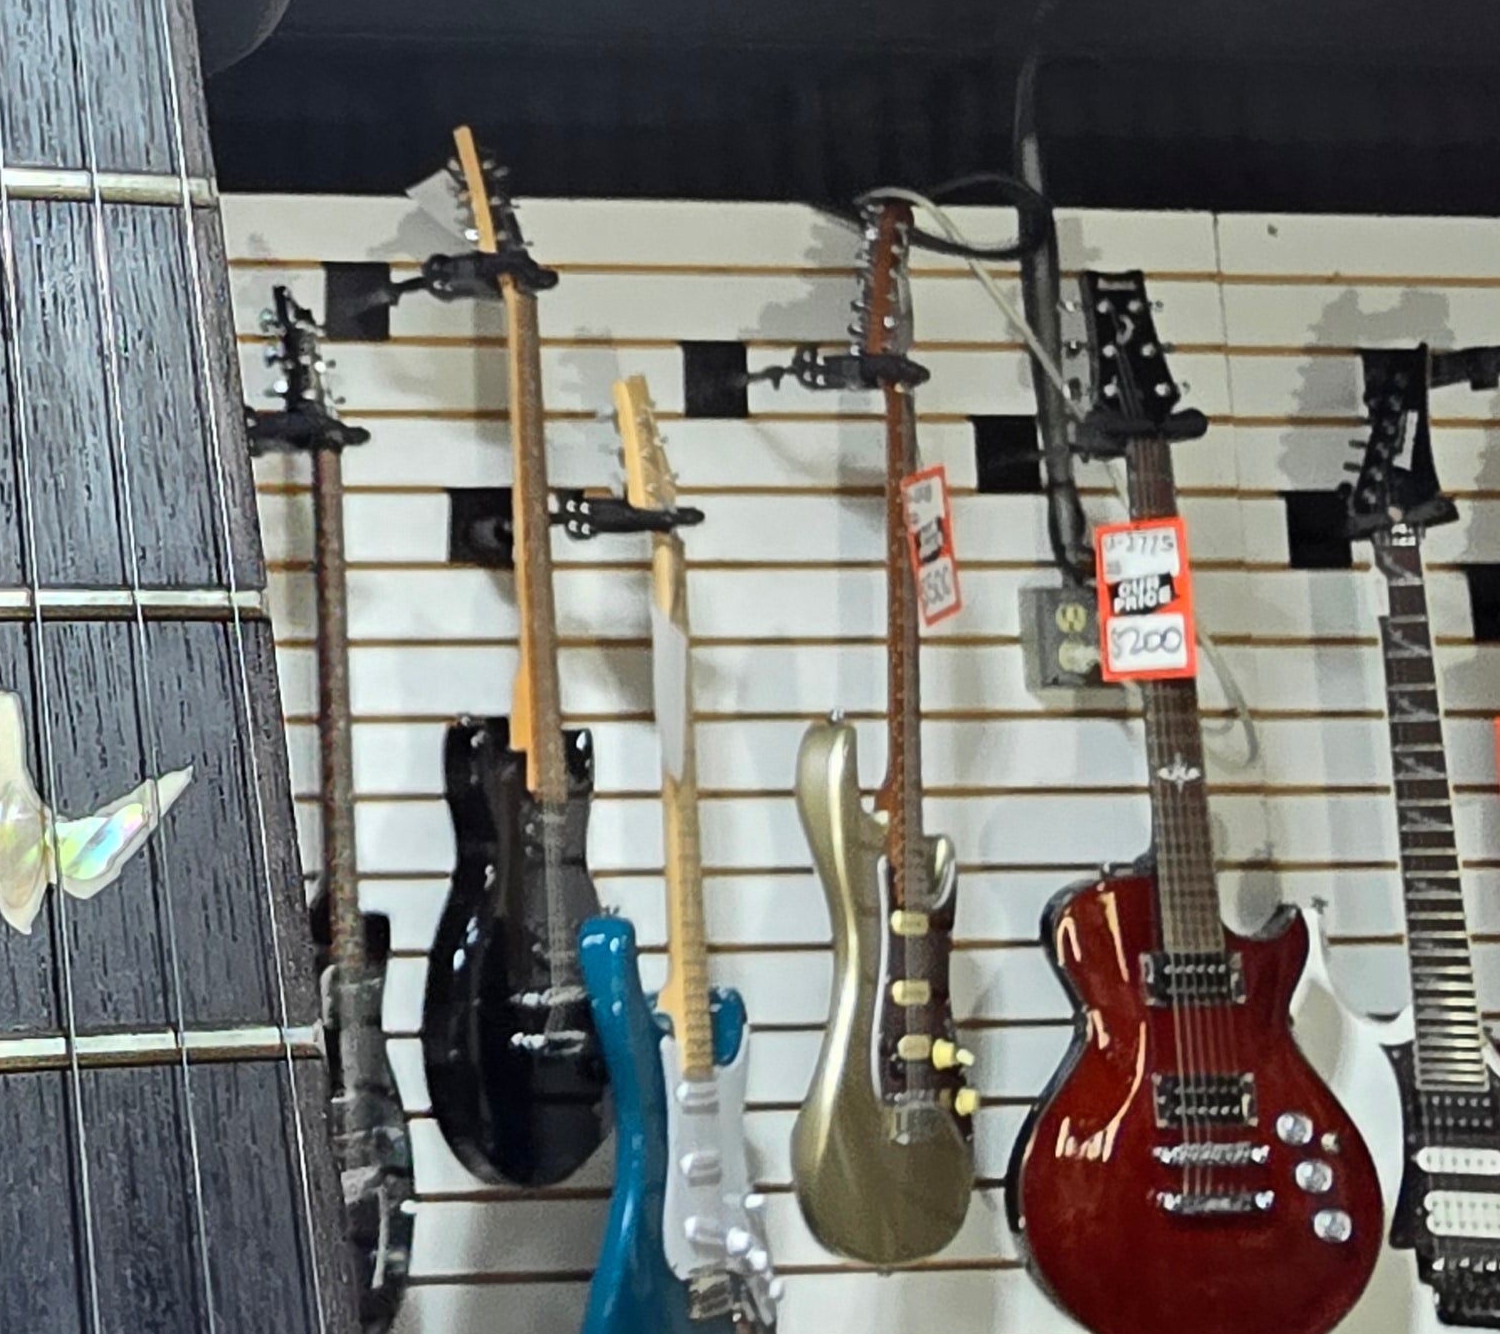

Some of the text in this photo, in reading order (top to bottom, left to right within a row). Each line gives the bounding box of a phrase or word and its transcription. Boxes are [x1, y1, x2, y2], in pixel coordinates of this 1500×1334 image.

[1113, 585, 1172, 615] PRICE
[1117, 576, 1160, 599] OUR
[1110, 626, 1183, 661] $200
